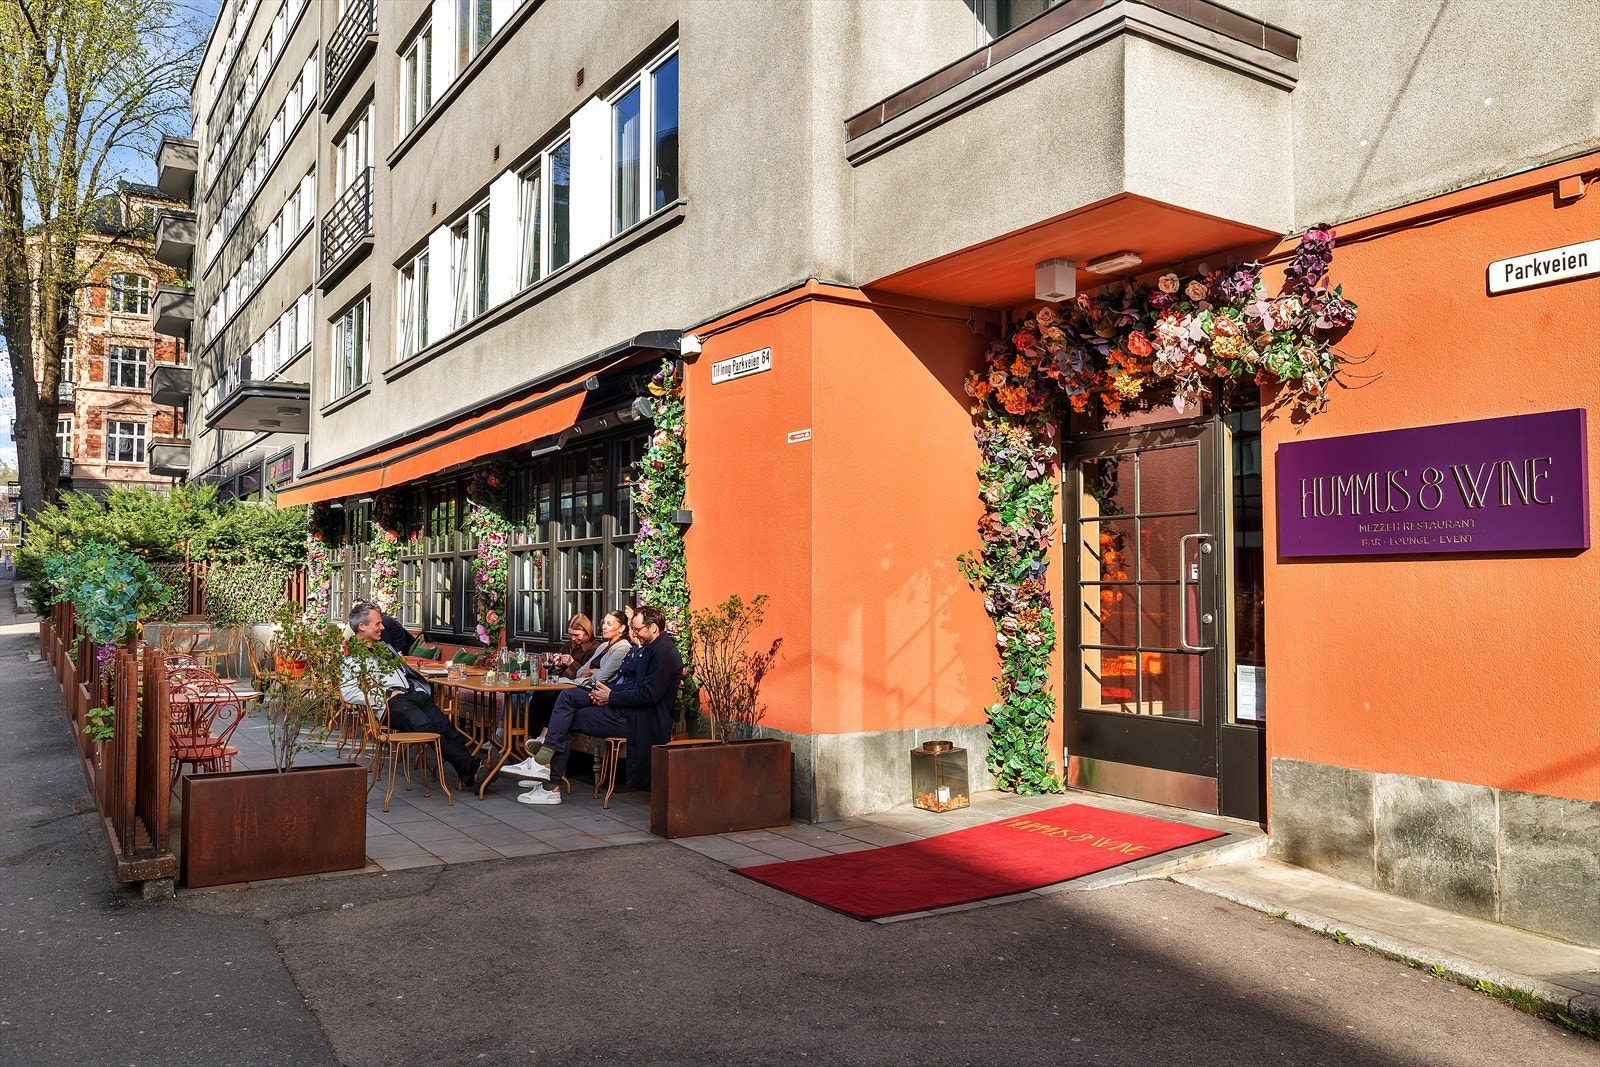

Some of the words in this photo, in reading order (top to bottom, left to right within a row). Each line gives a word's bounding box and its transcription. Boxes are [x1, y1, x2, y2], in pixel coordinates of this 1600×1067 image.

[1505, 251, 1588, 282] Parkveien
[732, 355, 760, 373] Parkveien
[761, 350, 770, 364] 64
[1299, 468, 1411, 518] HUMMUS
[1418, 467, 1444, 511] &
[1449, 456, 1553, 508] WINE
[1403, 518, 1476, 531] RESTAURANT
[1361, 538, 1381, 547] BAR
[1391, 536, 1430, 546] LOUNGE
[1440, 534, 1474, 544] EVENT
[1000, 818, 1077, 838] HUMMUS
[1091, 837, 1153, 856] WINE
